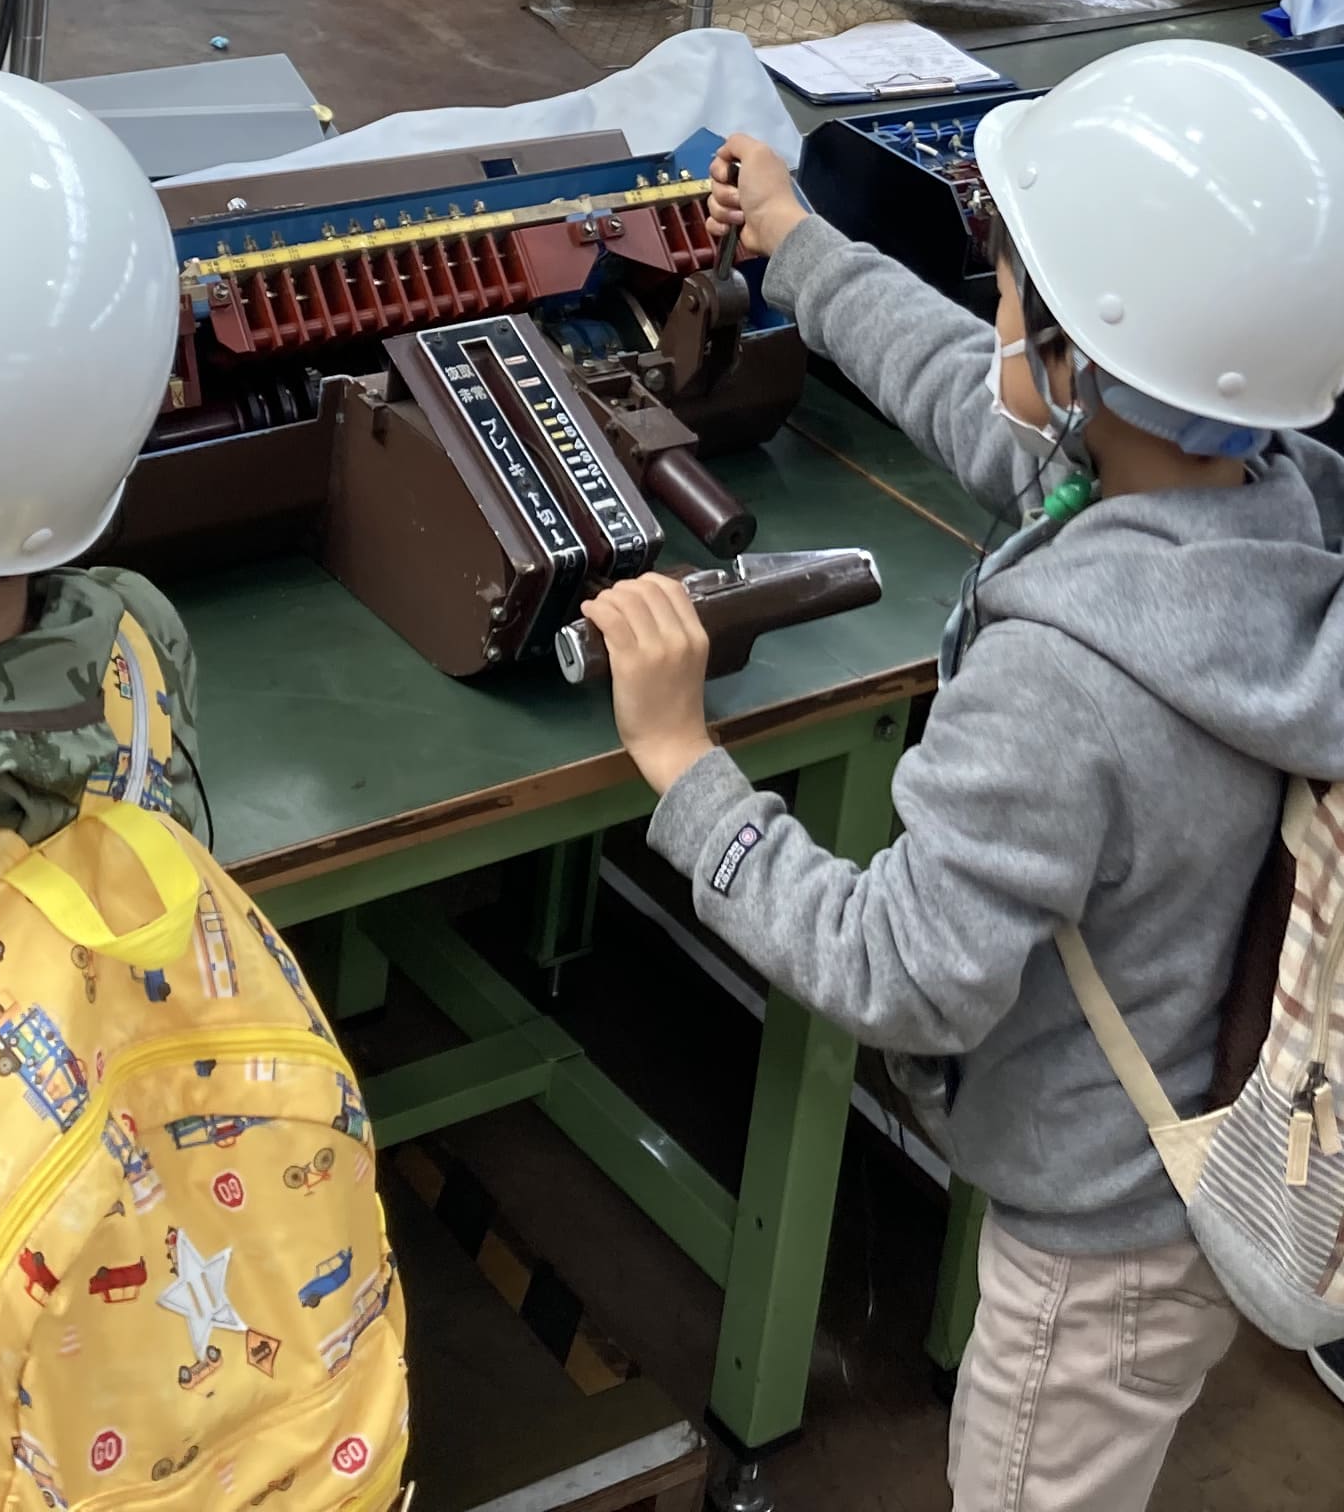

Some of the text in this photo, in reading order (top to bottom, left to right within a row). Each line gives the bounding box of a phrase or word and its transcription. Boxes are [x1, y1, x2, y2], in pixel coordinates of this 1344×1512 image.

[546, 397, 557, 410] 7
[556, 413, 568, 425] 6
[564, 425, 577, 438] 5
[573, 439, 586, 451] 4
[580, 451, 593, 463] 3
[588, 463, 602, 476] 2
[597, 476, 607, 489] 1
[94, 1437, 122, 1465] GO
[336, 1443, 364, 1471] GO
